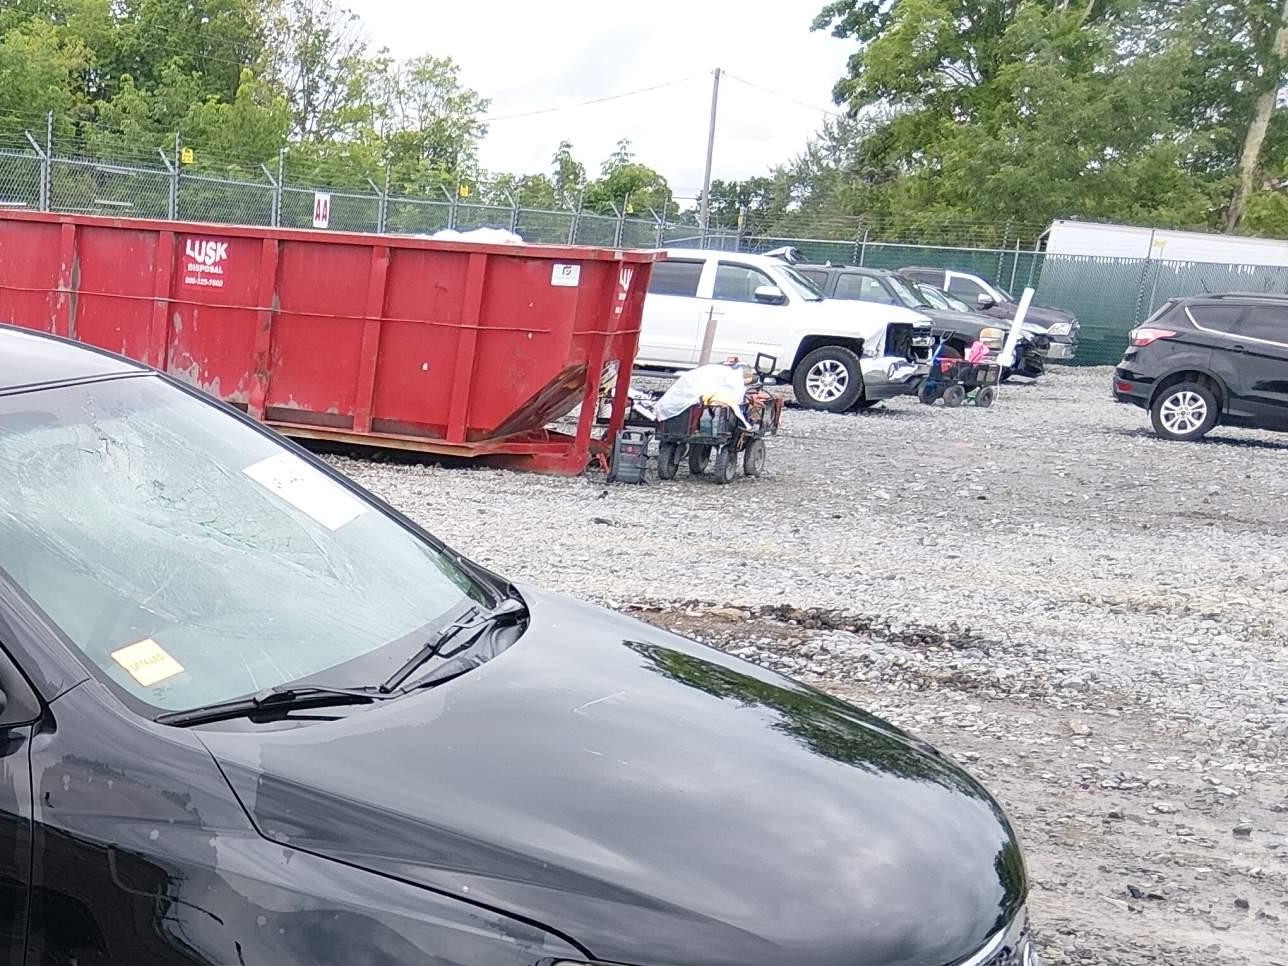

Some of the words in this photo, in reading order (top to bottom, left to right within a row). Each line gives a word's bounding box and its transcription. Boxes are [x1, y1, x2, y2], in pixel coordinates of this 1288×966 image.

[314, 198, 328, 223] AA
[185, 239, 229, 265] LUSK
[187, 263, 224, 275] DISPOSAL
